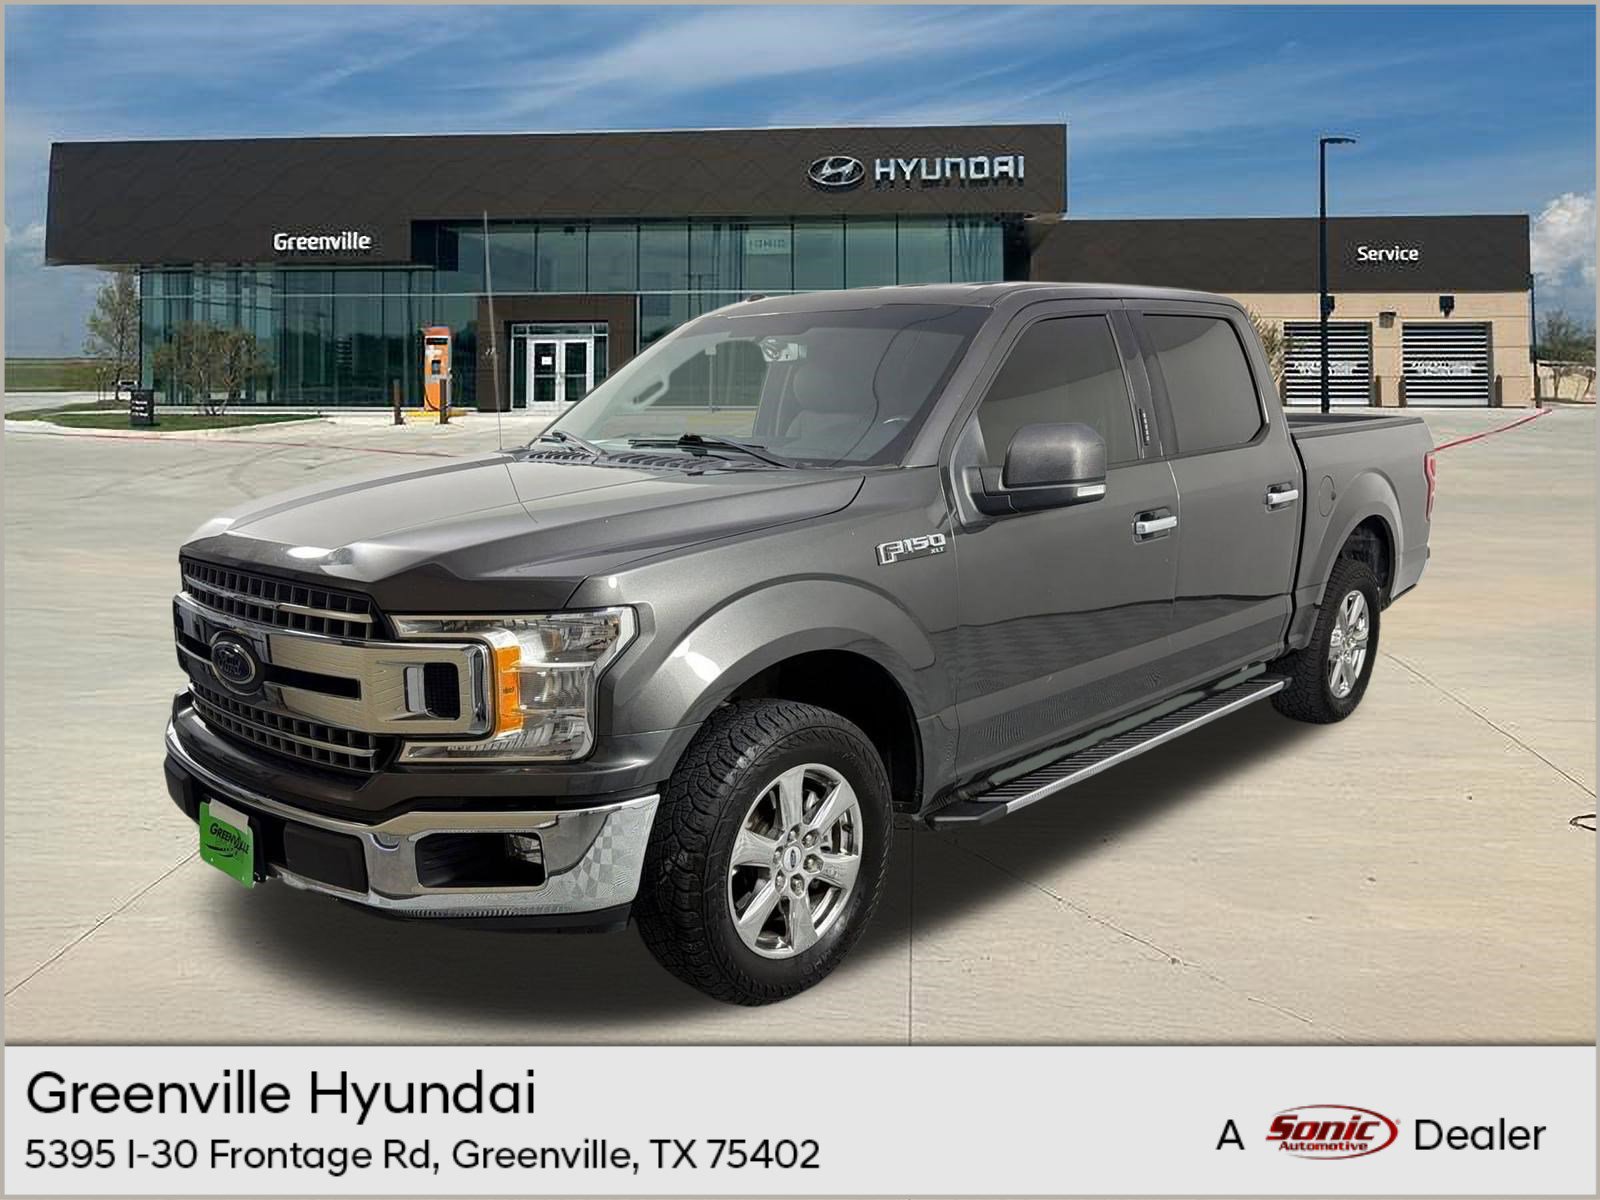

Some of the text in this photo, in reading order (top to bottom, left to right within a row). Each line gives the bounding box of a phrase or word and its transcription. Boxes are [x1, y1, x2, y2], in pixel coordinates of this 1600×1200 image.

[874, 155, 1025, 181] HYUNDAI
[273, 231, 371, 251] Greenville
[1357, 245, 1419, 261] Service
